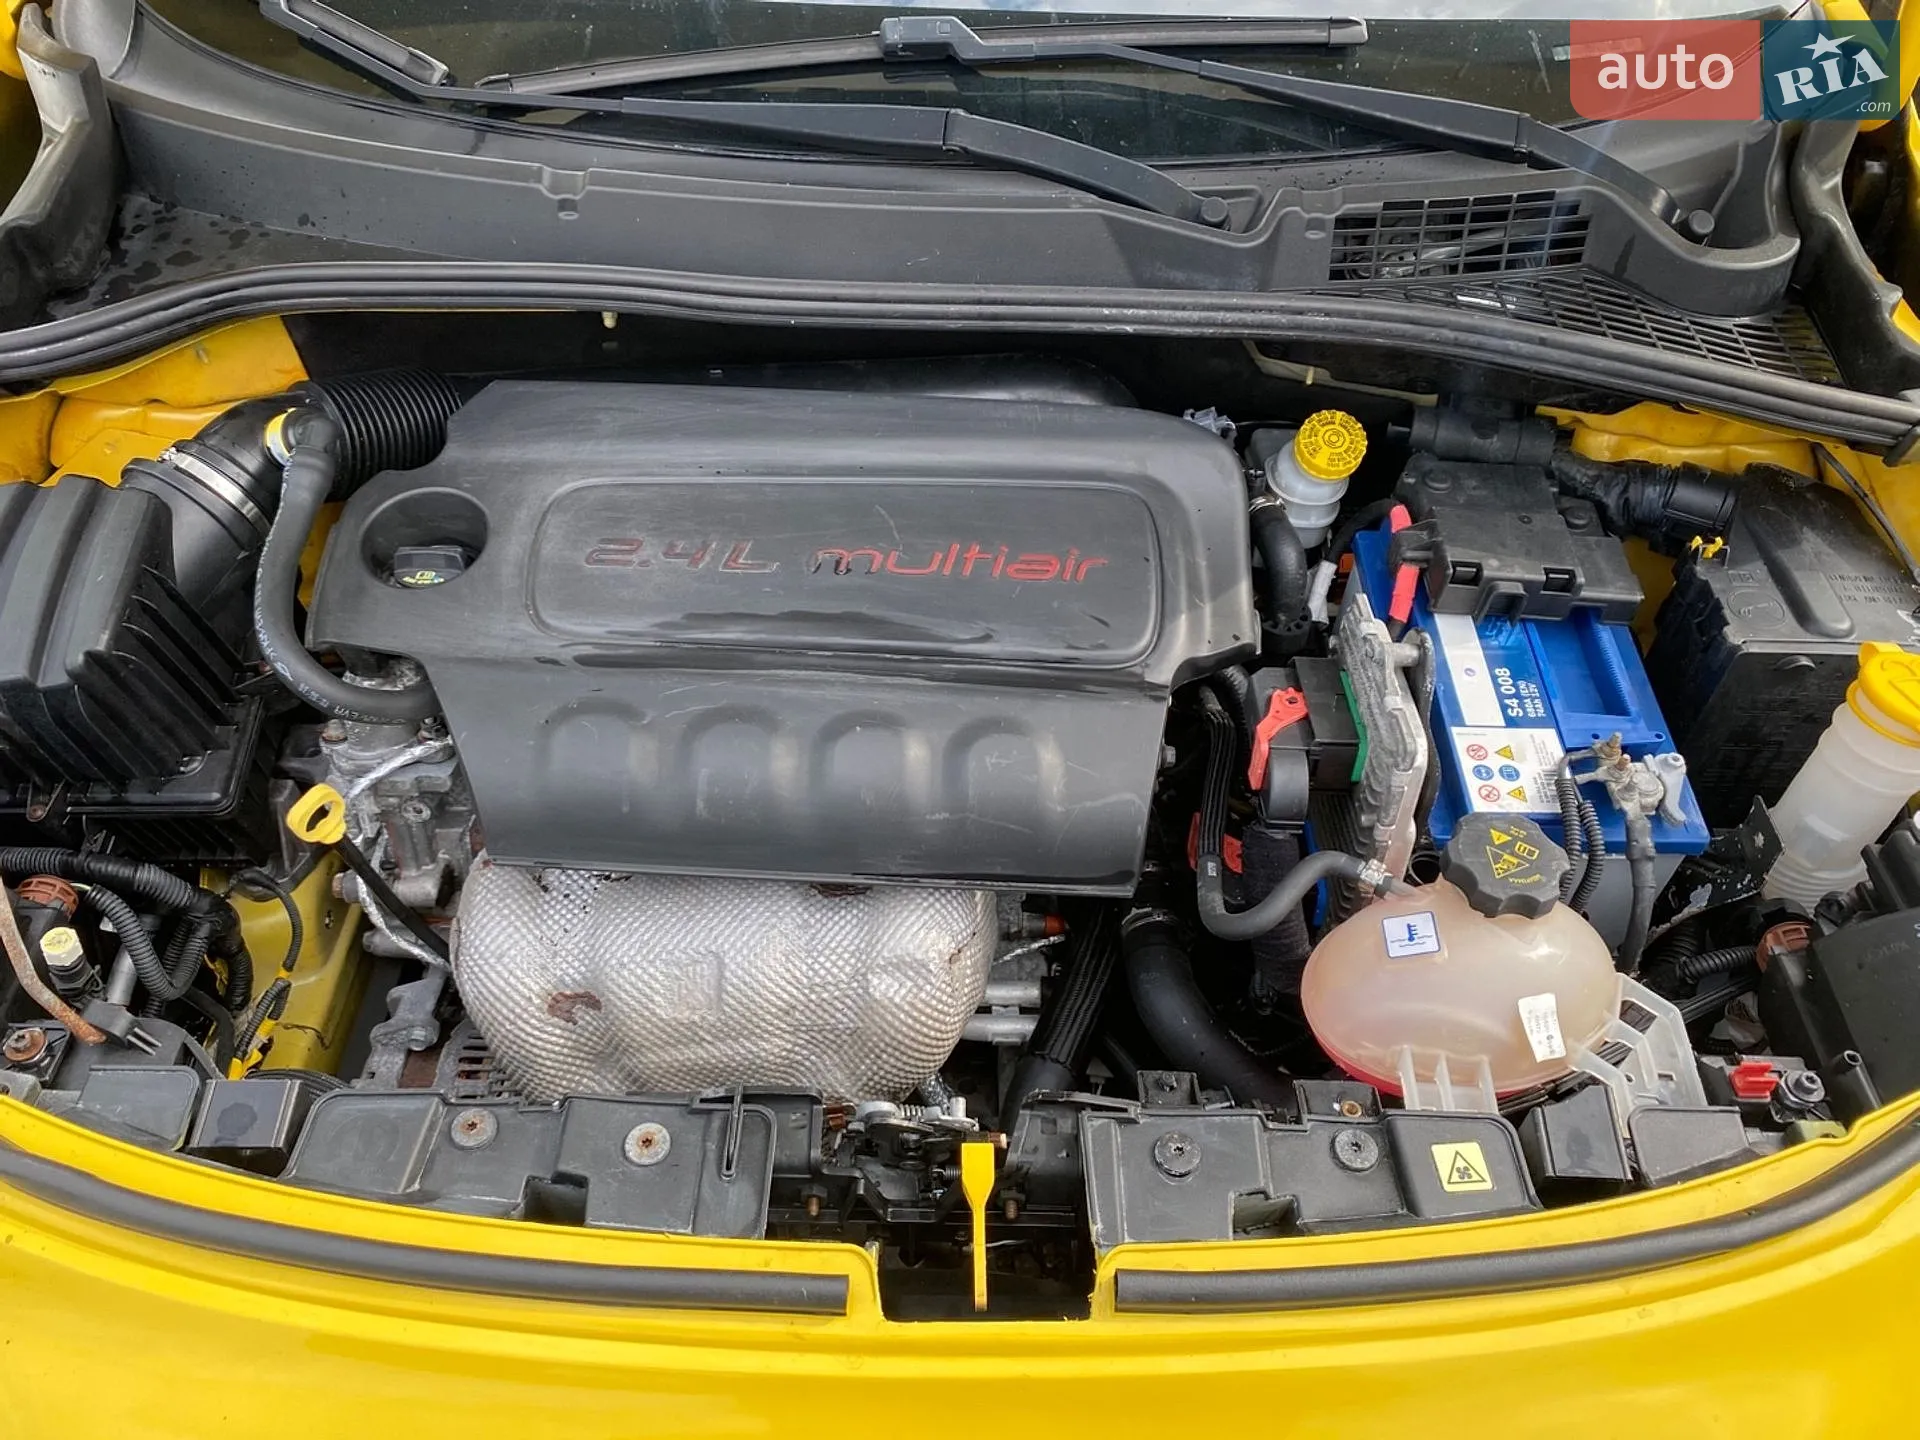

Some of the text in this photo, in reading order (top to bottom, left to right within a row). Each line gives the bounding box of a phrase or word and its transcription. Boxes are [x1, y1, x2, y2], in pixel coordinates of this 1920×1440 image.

[583, 536, 1109, 583] 2.4L multiair
[1494, 667, 1524, 717] S4 008
